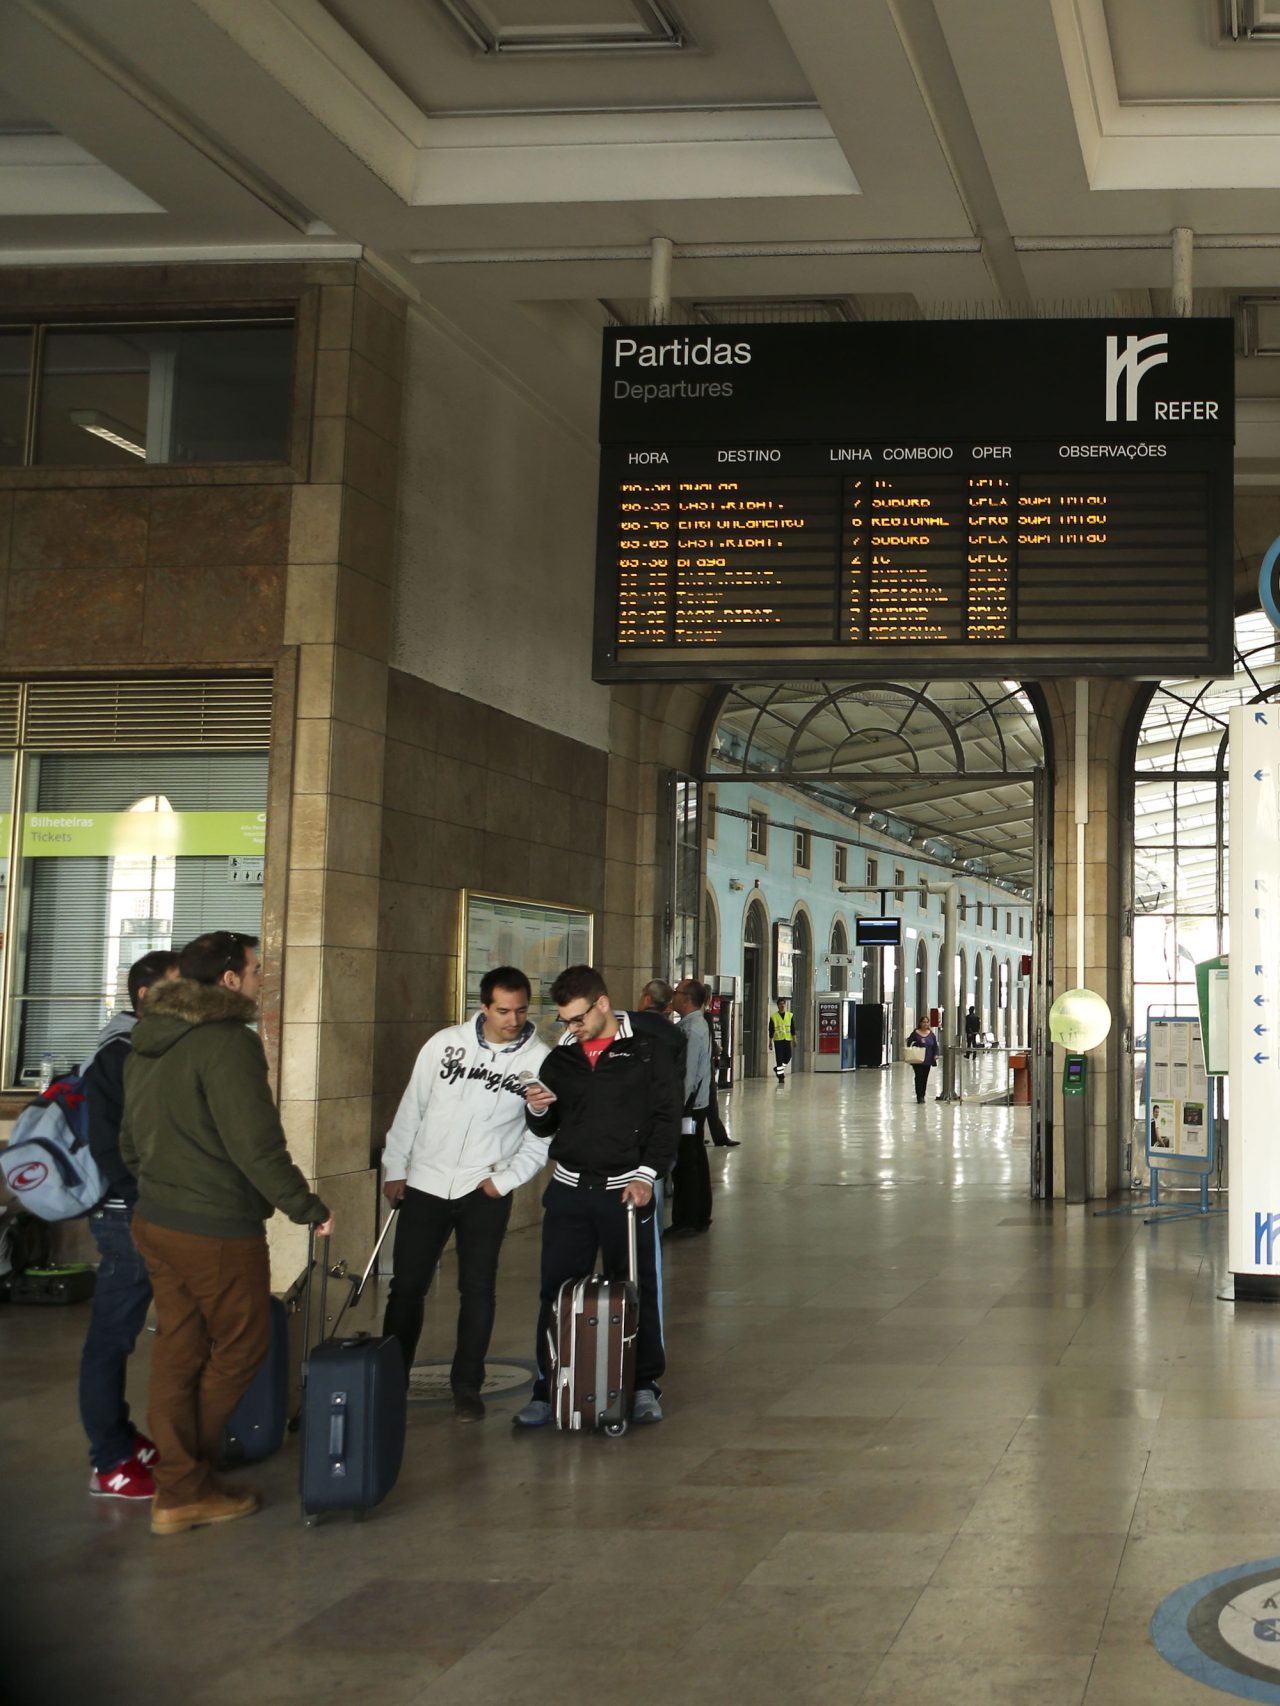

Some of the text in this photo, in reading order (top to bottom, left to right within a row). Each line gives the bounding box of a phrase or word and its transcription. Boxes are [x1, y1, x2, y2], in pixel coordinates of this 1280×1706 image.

[614, 336, 752, 367] Partidas
[613, 379, 733, 404] Departures
[1155, 401, 1219, 421] REFER
[628, 443, 1167, 465] HORA DESTINO LINHA COMBOIO OPER OBSERVAÇÕES
[31, 816, 94, 828] Bilheteiras
[30, 831, 72, 843] Tickets
[441, 1046, 466, 1069] 32
[108, 1448, 156, 1491] N N
